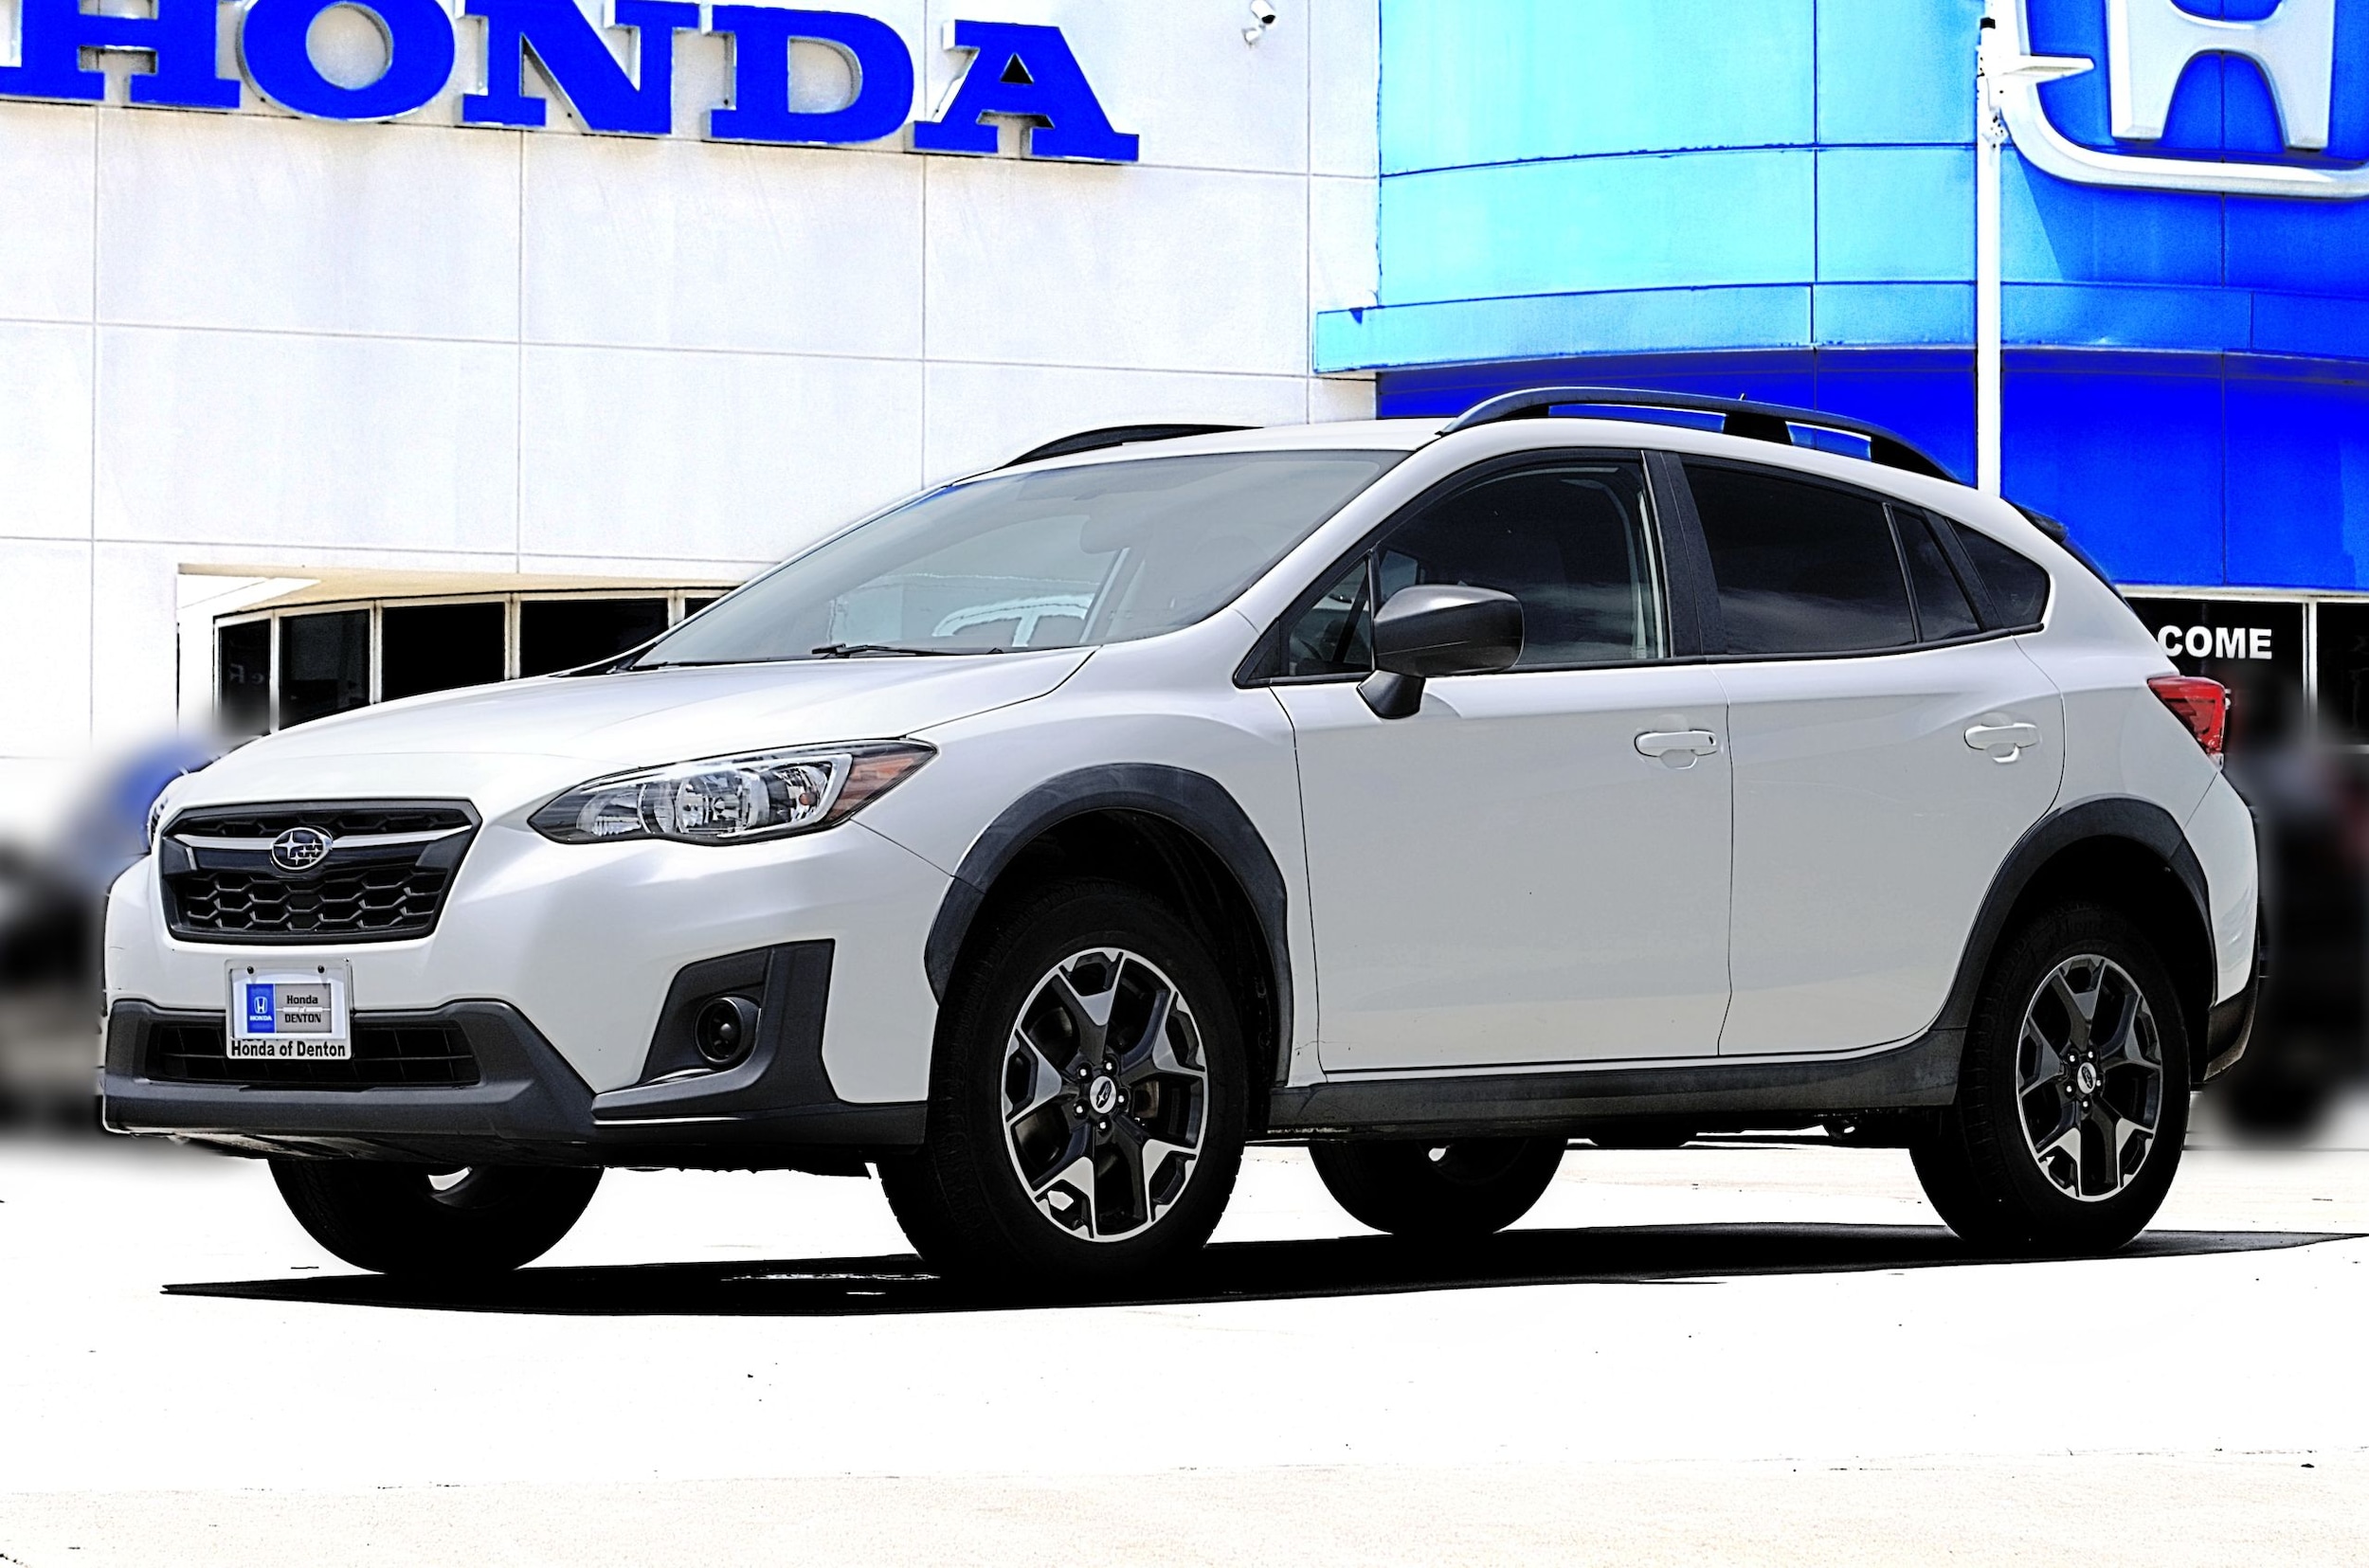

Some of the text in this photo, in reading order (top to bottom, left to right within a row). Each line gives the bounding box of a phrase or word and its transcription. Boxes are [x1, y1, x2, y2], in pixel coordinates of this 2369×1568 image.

[0, 0, 1139, 163] HONDA
[2157, 624, 2273, 660] COME
[287, 995, 318, 1004] Honda
[285, 1014, 321, 1023] DENTON
[231, 1040, 346, 1056] Honda of Denton
